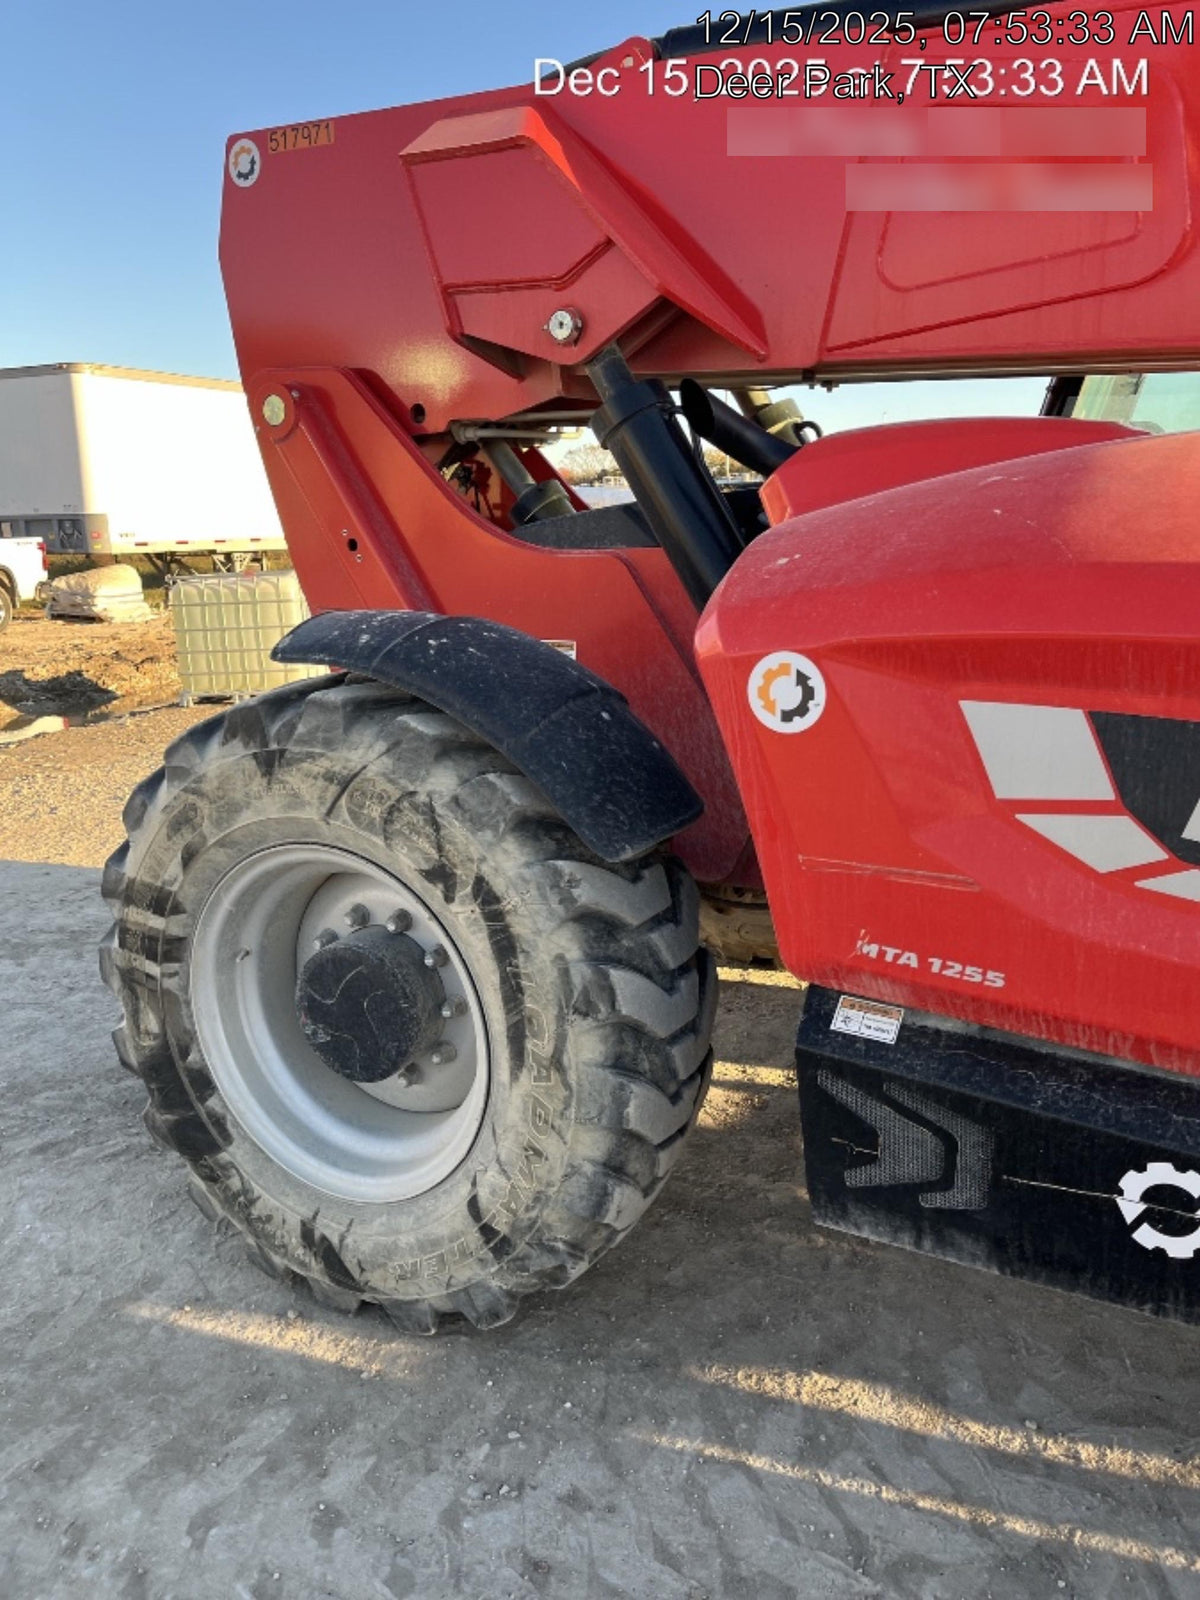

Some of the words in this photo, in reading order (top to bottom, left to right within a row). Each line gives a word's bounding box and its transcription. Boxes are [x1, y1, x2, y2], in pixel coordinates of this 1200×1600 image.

[268, 122, 332, 152] 517971
[856, 939, 918, 968] MTA
[927, 957, 1006, 988] 1255
